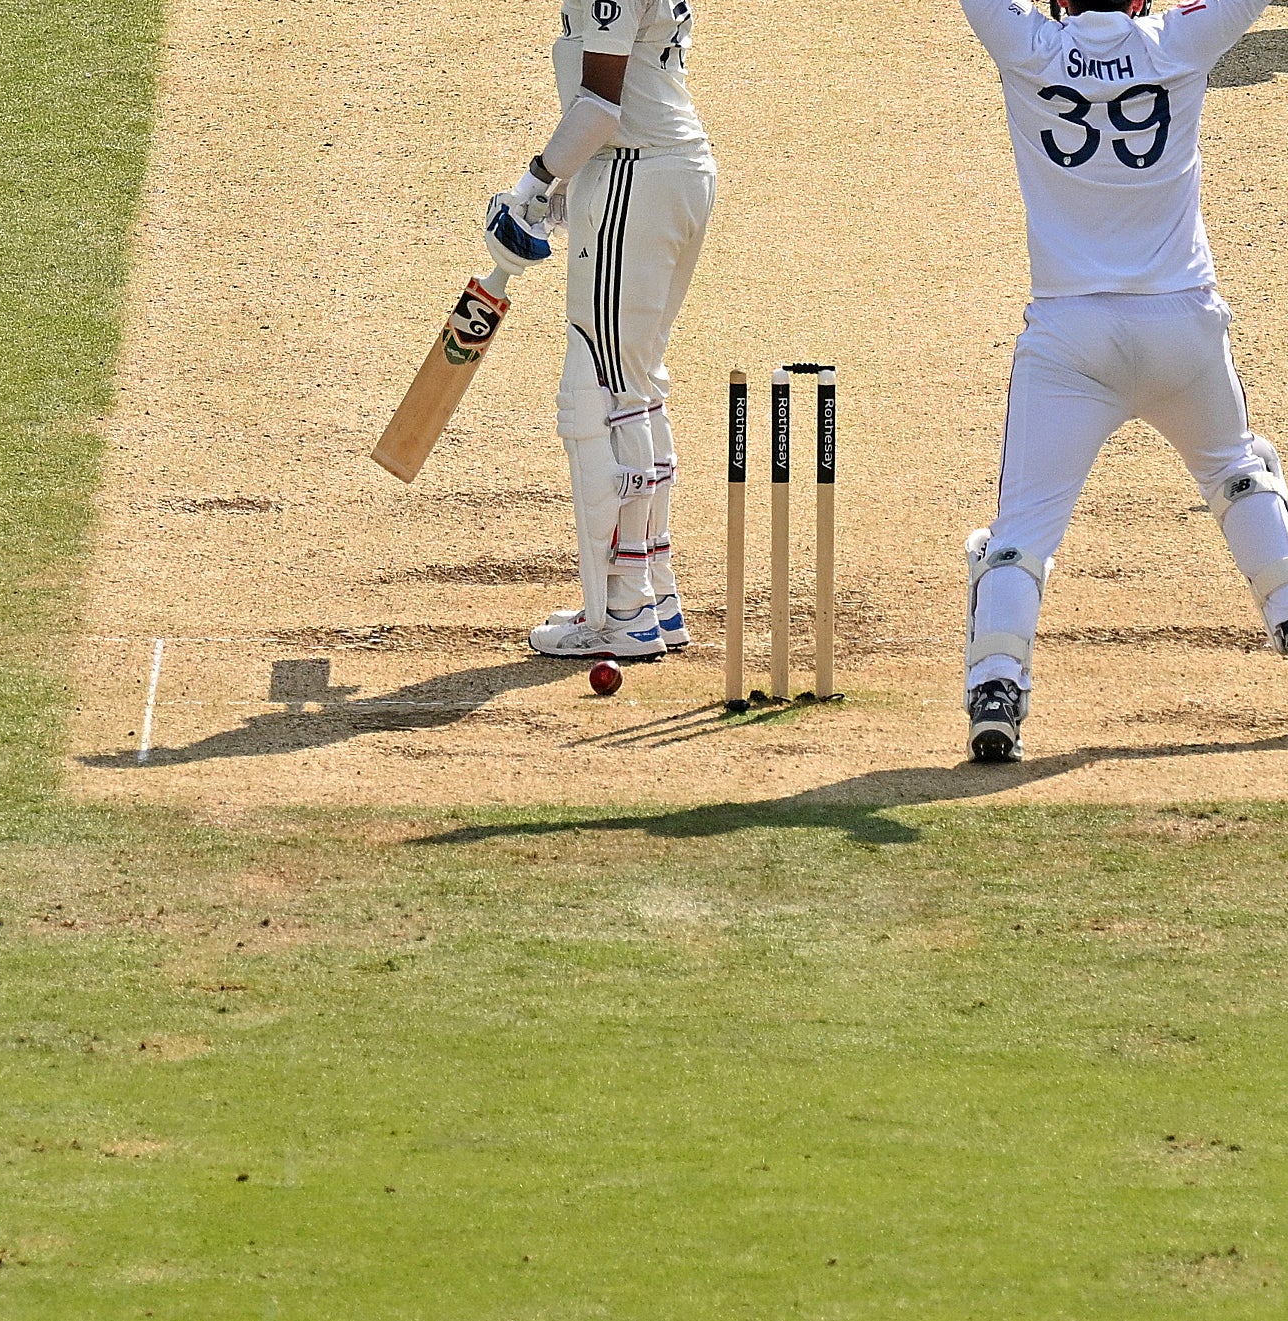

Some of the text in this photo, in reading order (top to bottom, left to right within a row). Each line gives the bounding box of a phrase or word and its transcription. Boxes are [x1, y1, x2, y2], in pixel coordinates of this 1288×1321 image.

[1067, 48, 1134, 82] SMITH
[1037, 83, 1172, 169] 39
[733, 397, 746, 469] Rothesay
[776, 397, 789, 470] Rothesay
[822, 398, 834, 470] Rothesay
